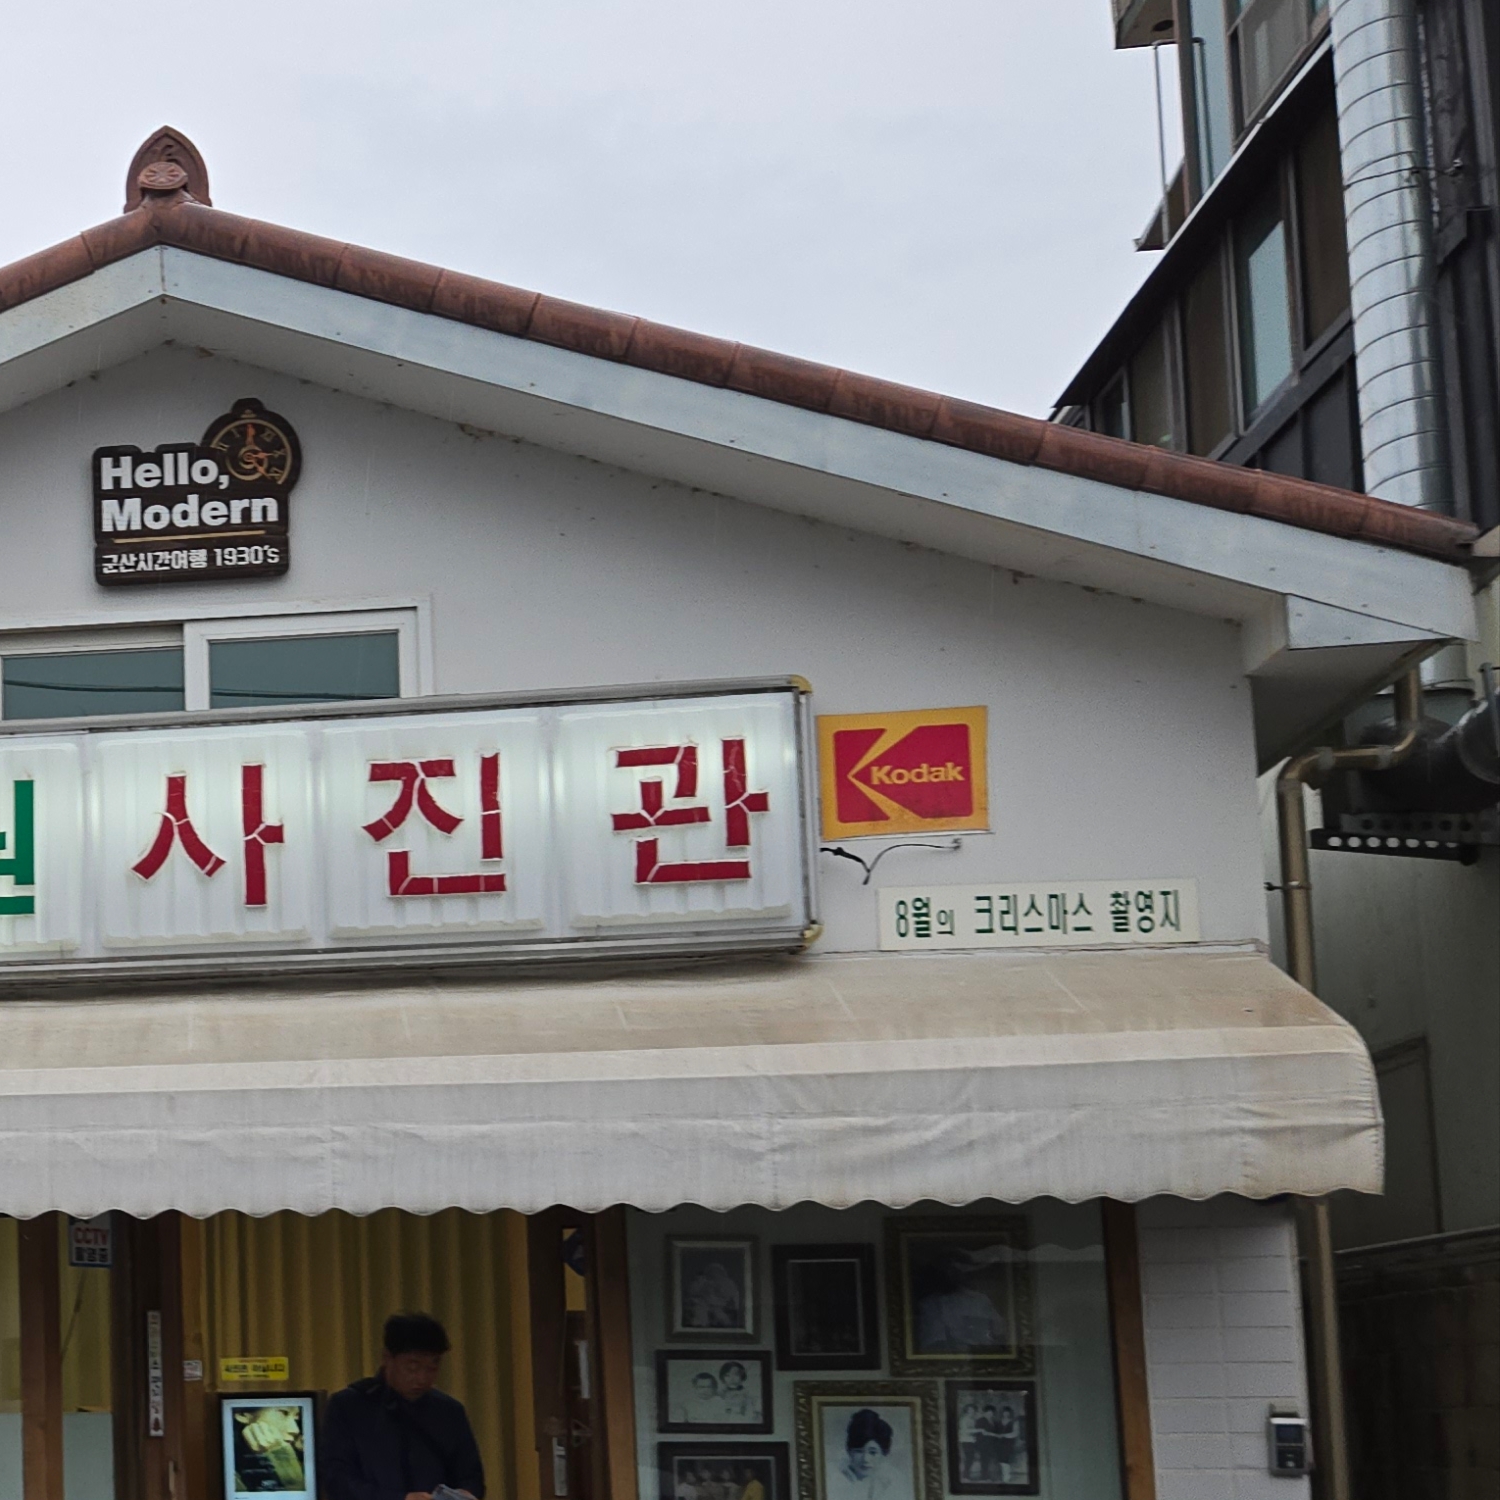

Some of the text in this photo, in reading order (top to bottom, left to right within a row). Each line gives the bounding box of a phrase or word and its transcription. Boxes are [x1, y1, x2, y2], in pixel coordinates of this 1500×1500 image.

[100, 452, 229, 490] Hello,
[100, 494, 279, 532] Modern
[102, 549, 208, 574] 군산시간여행
[870, 762, 965, 785] Kodak
[895, 889, 1182, 939] 8월의 크리스마스 촬영지
[74, 1227, 109, 1246] CCTV
